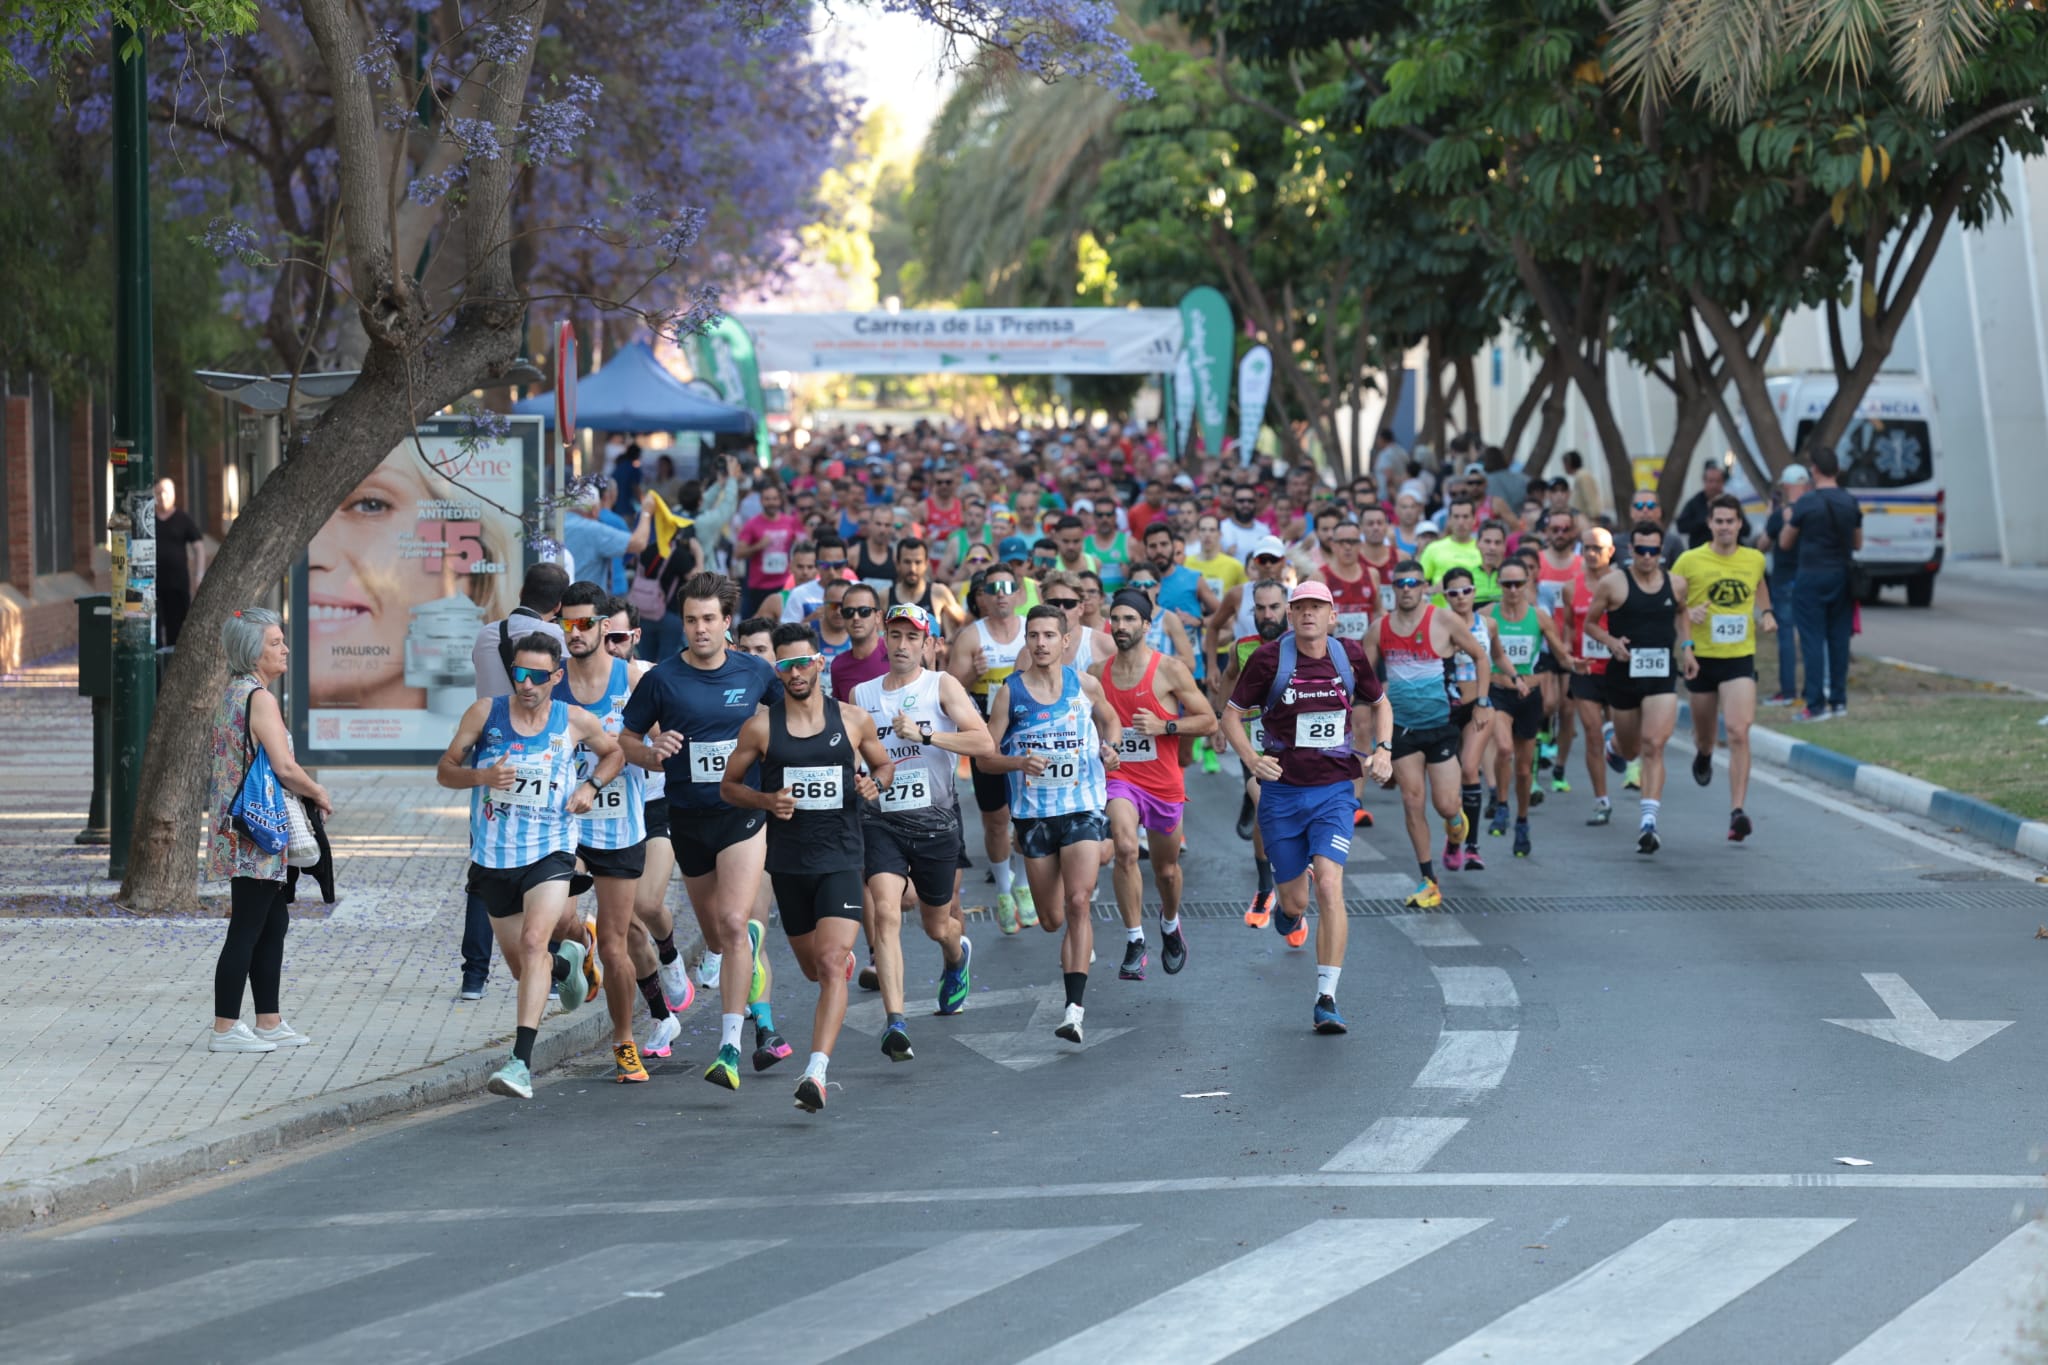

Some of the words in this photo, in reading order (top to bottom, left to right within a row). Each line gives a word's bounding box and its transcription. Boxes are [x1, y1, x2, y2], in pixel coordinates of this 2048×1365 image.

[854, 316, 935, 334] Carrera
[942, 315, 969, 334] de
[975, 315, 993, 333] la
[1001, 315, 1075, 333] Prensa
[417, 509, 481, 519] ANTIEDAD
[470, 558, 506, 574] días
[1716, 624, 1744, 635] 432
[331, 645, 391, 656] HYALURON
[1634, 657, 1665, 669] 336
[1298, 691, 1316, 699] Save
[1316, 690, 1328, 698] the
[1309, 723, 1335, 738] 28
[791, 781, 837, 799] 668
[885, 782, 925, 802] 278
